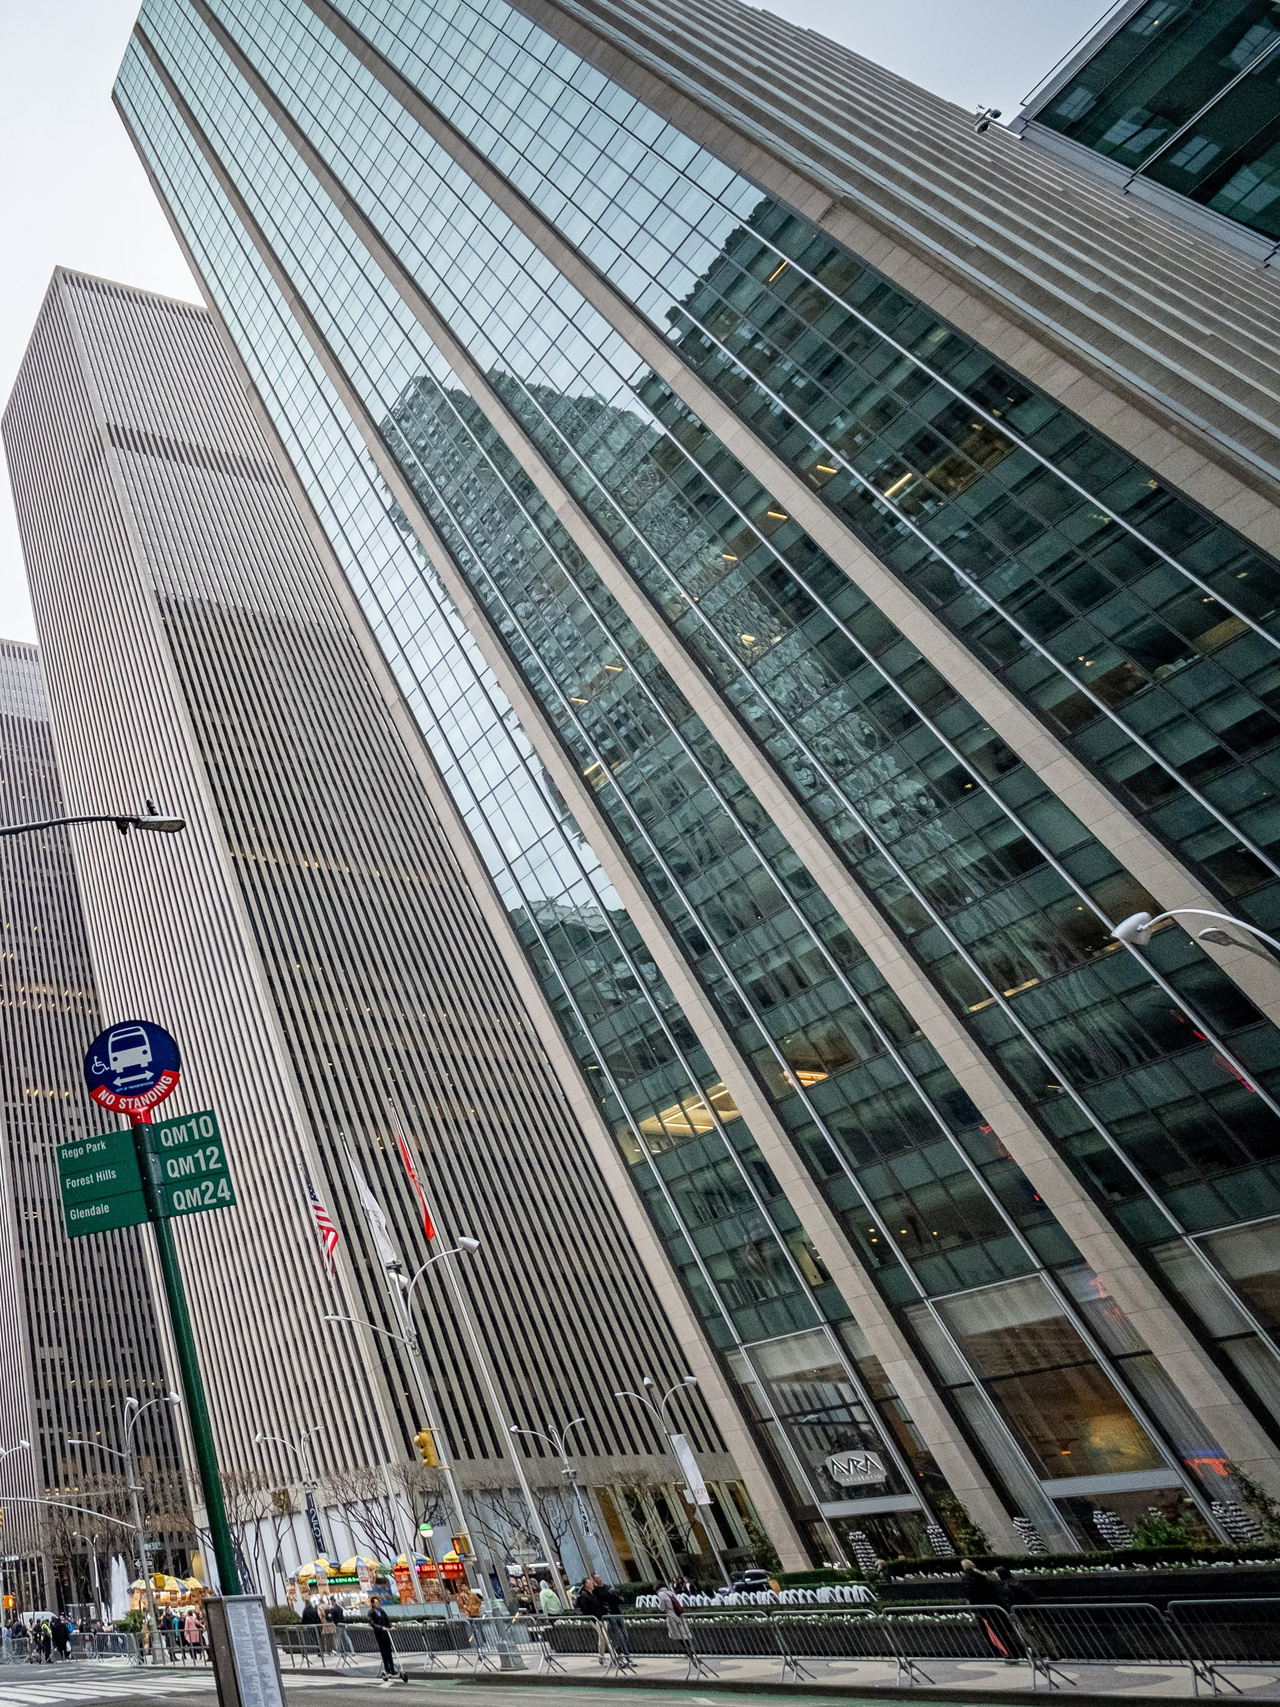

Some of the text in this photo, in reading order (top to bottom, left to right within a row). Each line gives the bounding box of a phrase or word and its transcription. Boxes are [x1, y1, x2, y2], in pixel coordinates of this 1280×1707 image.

[97, 1075, 173, 1109] NO STANDING
[160, 1115, 214, 1147] QM10
[61, 1140, 107, 1159] Rego Park
[166, 1146, 222, 1178] QM12
[66, 1169, 117, 1189] Forest Hills
[172, 1178, 231, 1211] QM24
[69, 1203, 110, 1220] Glendale
[830, 1453, 883, 1476] AVRA
[308, 1494, 325, 1552] 1251
